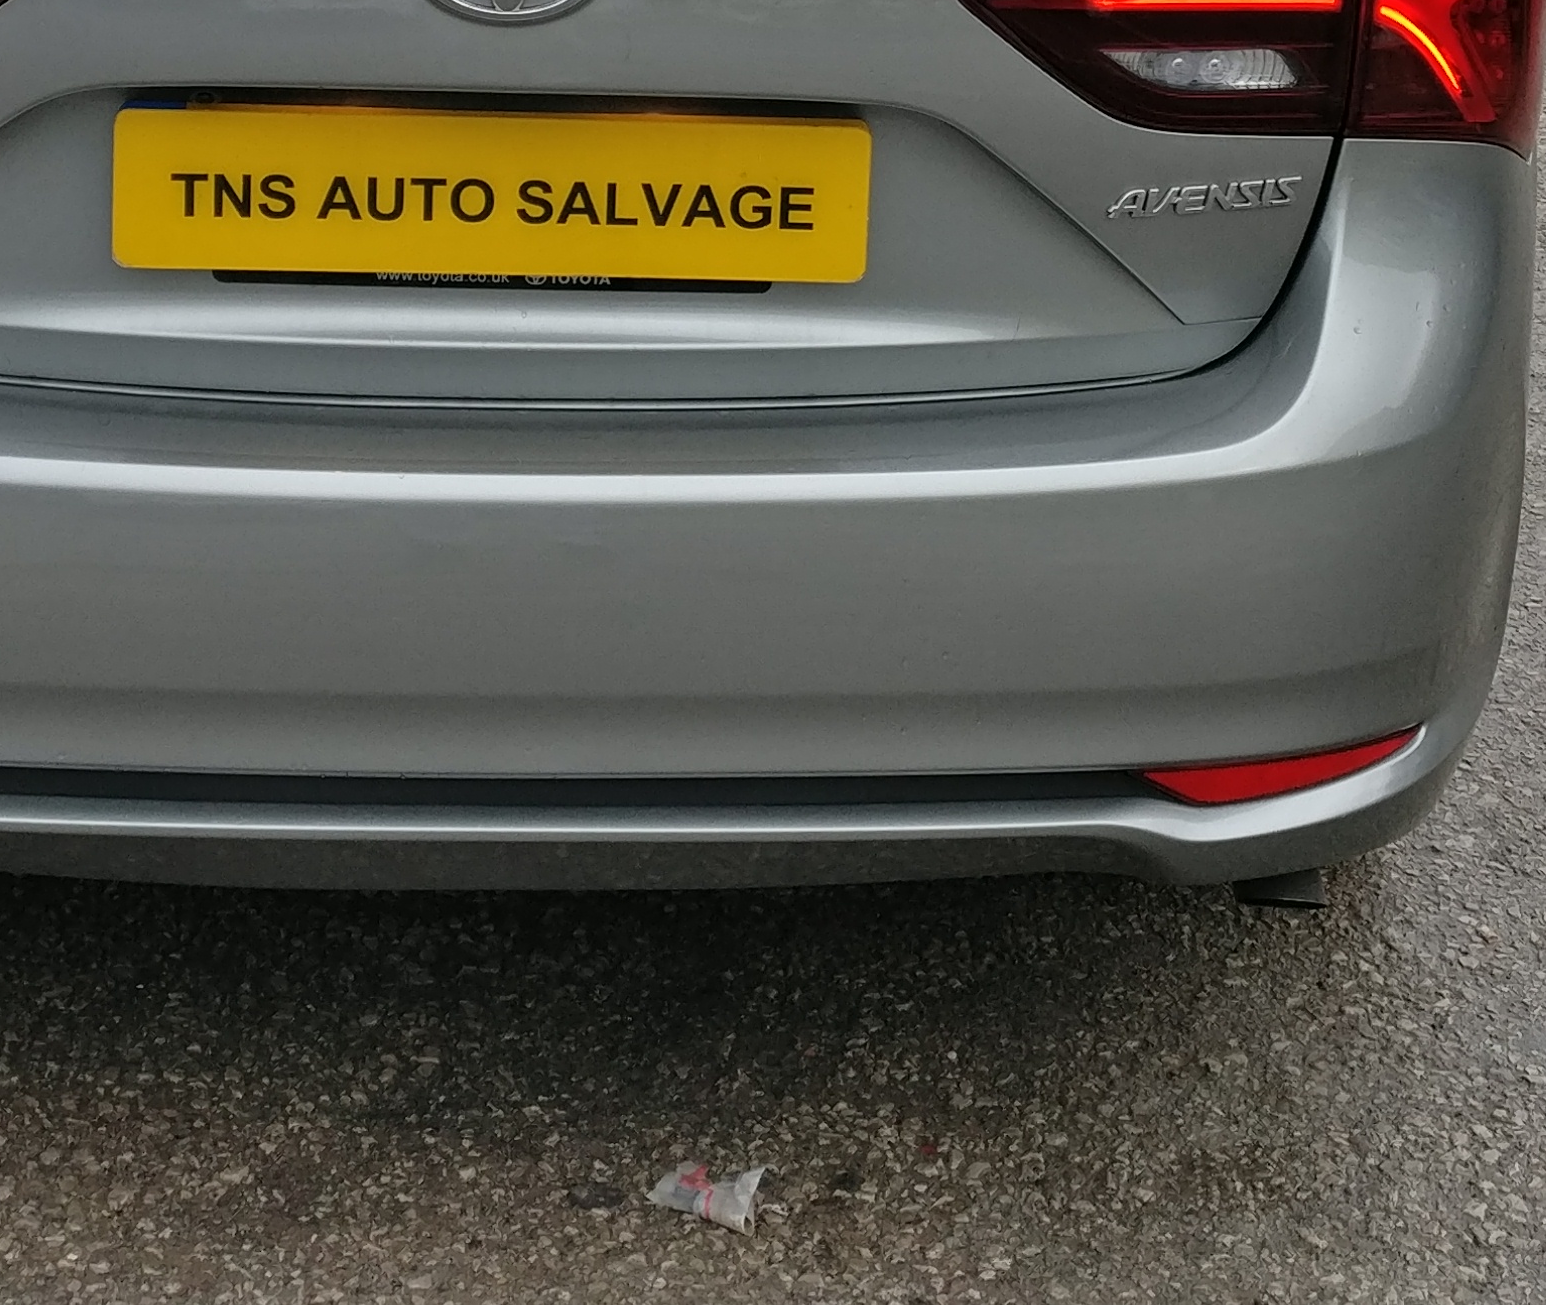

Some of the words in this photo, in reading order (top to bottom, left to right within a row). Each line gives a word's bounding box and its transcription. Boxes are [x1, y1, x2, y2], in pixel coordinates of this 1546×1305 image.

[170, 173, 296, 220] TNS
[316, 175, 496, 224] AUTO
[516, 179, 815, 232] SALVAGE
[1106, 175, 1303, 219] AVENSIS
